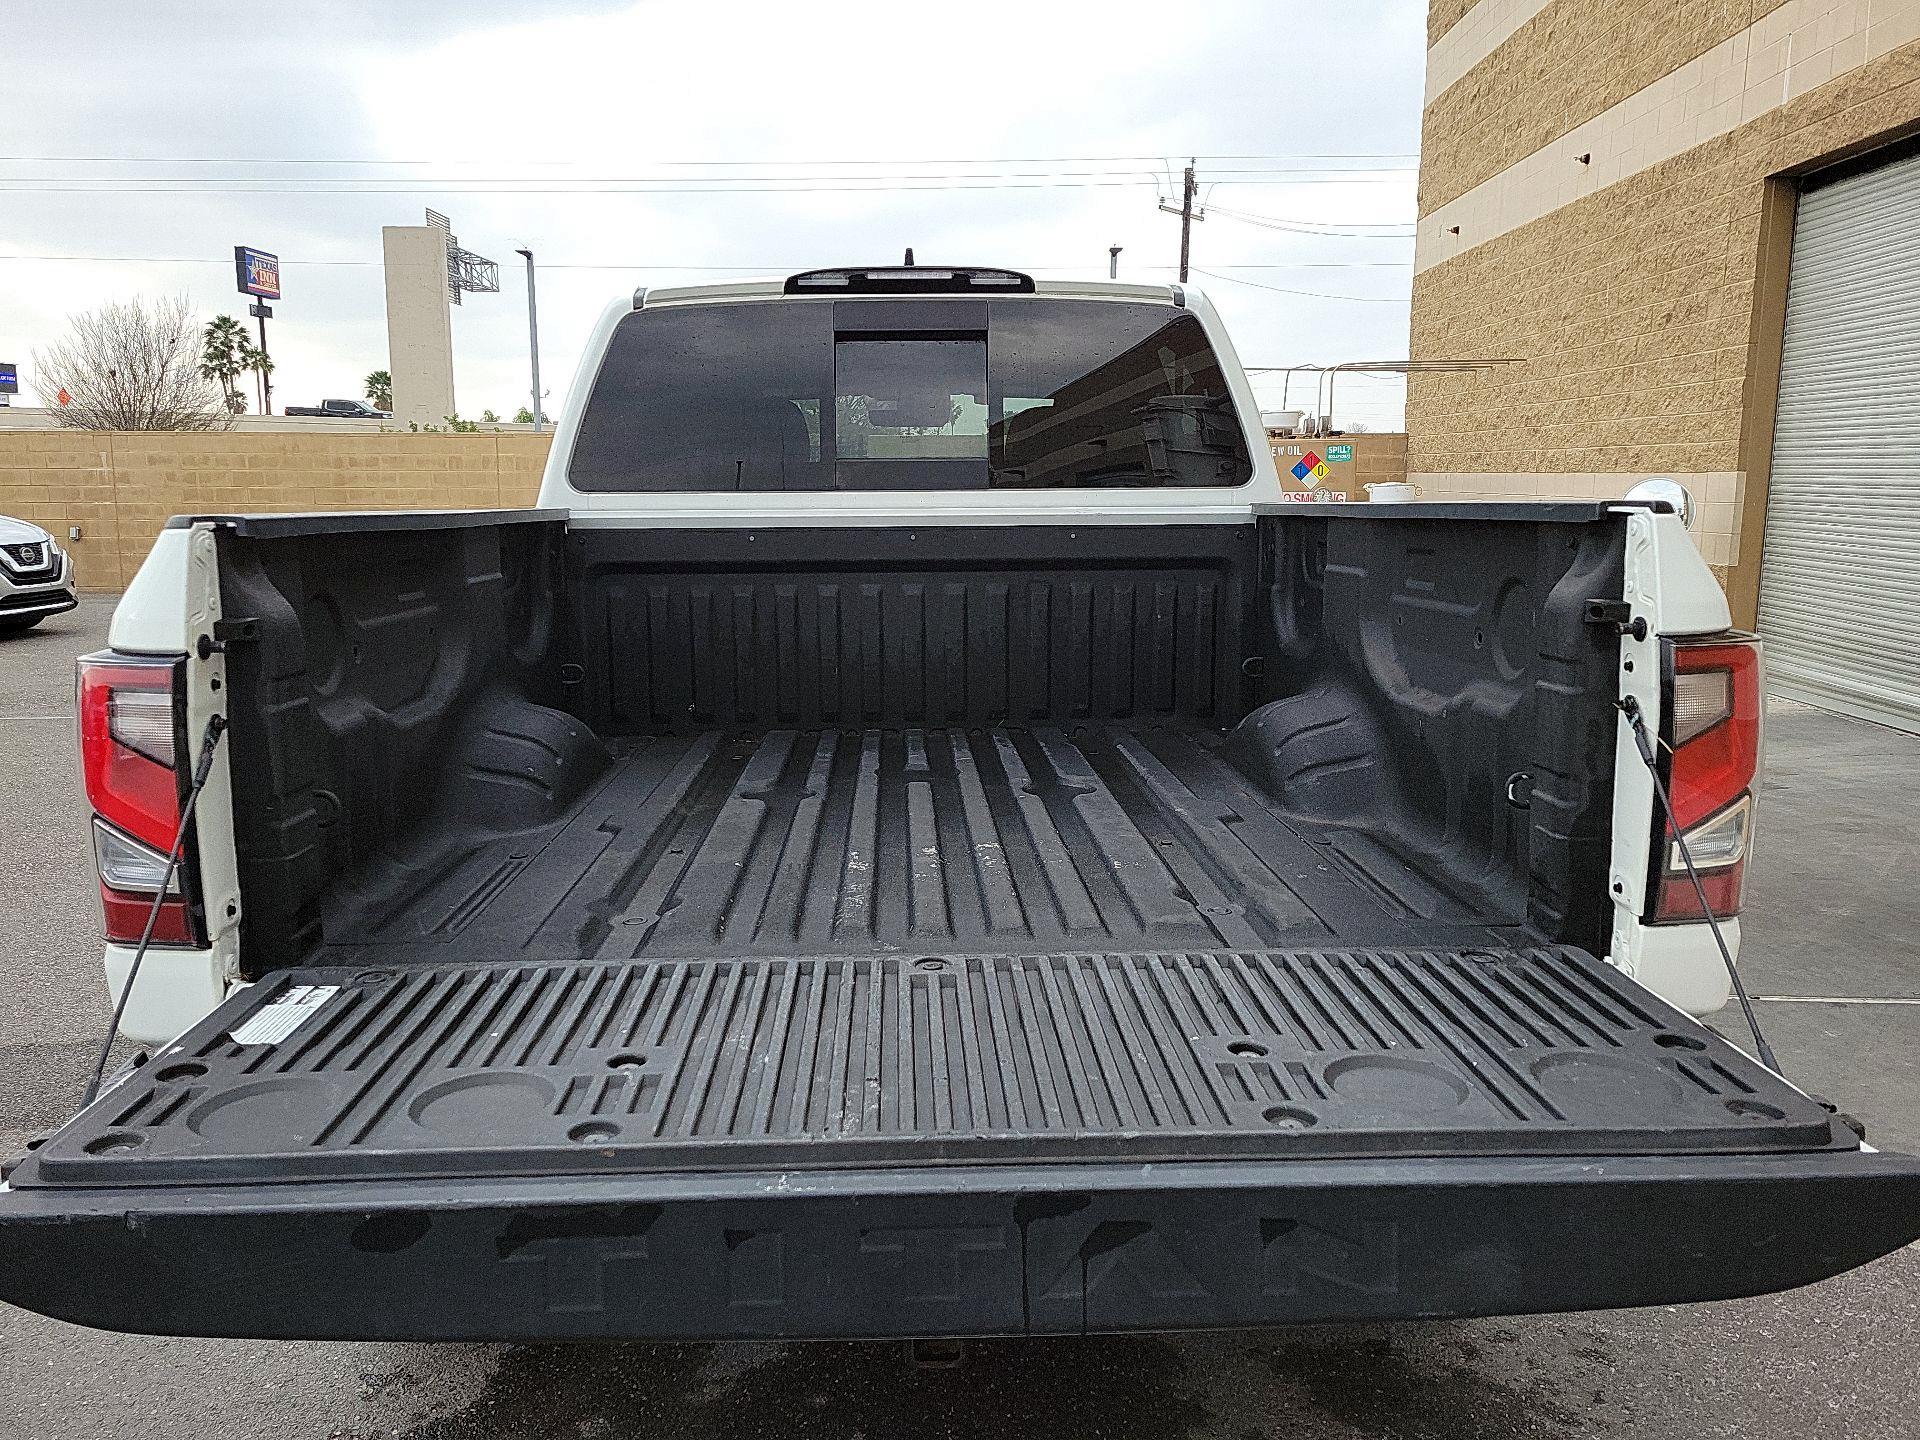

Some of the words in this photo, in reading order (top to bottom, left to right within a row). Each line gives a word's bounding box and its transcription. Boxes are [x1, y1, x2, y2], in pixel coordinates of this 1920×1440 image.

[259, 270, 277, 284] INN
[1287, 445, 1302, 456] OIL
[1328, 445, 1351, 454] SPILL?
[1317, 464, 1324, 477] 0
[498, 1221, 1399, 1314] TITAN
